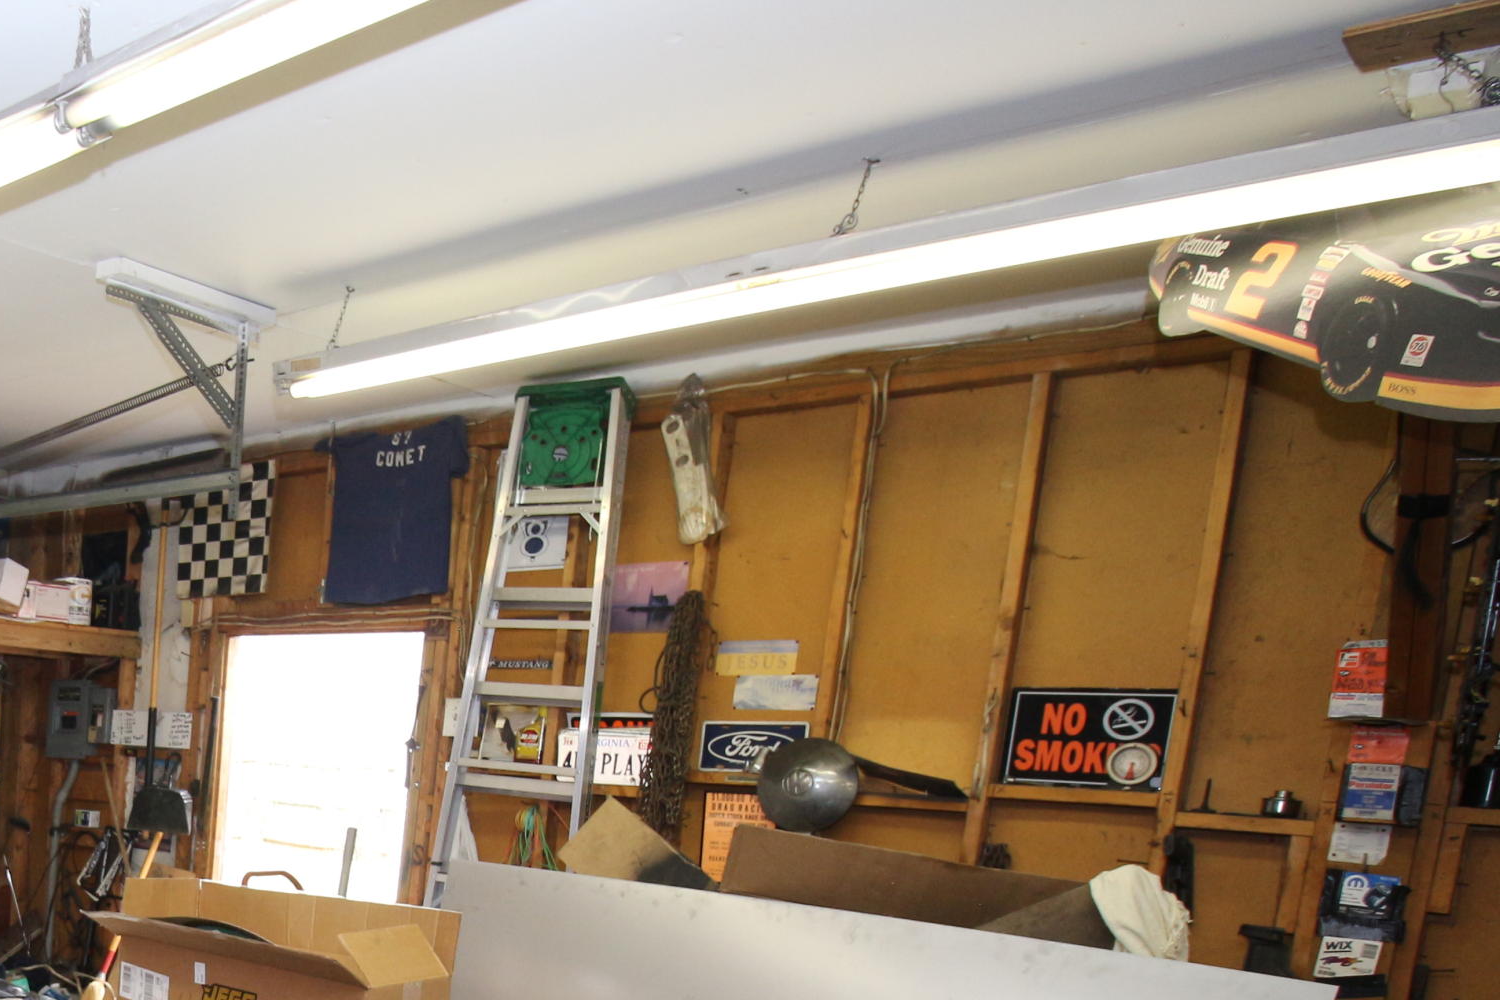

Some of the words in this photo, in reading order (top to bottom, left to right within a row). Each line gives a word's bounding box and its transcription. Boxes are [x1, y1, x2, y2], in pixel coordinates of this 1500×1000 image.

[1191, 264, 1231, 291] Draft
[1223, 239, 1300, 320] 2
[1412, 339, 1427, 352] 76
[375, 445, 426, 467] COMET
[497, 660, 550, 669] MUSTANG
[1040, 703, 1088, 736] NO
[596, 739, 630, 748] RGINIA
[724, 735, 781, 757] Ford
[601, 752, 649, 778] PLAY
[1013, 738, 1162, 774] SMOK
[1325, 940, 1353, 951] WIX
